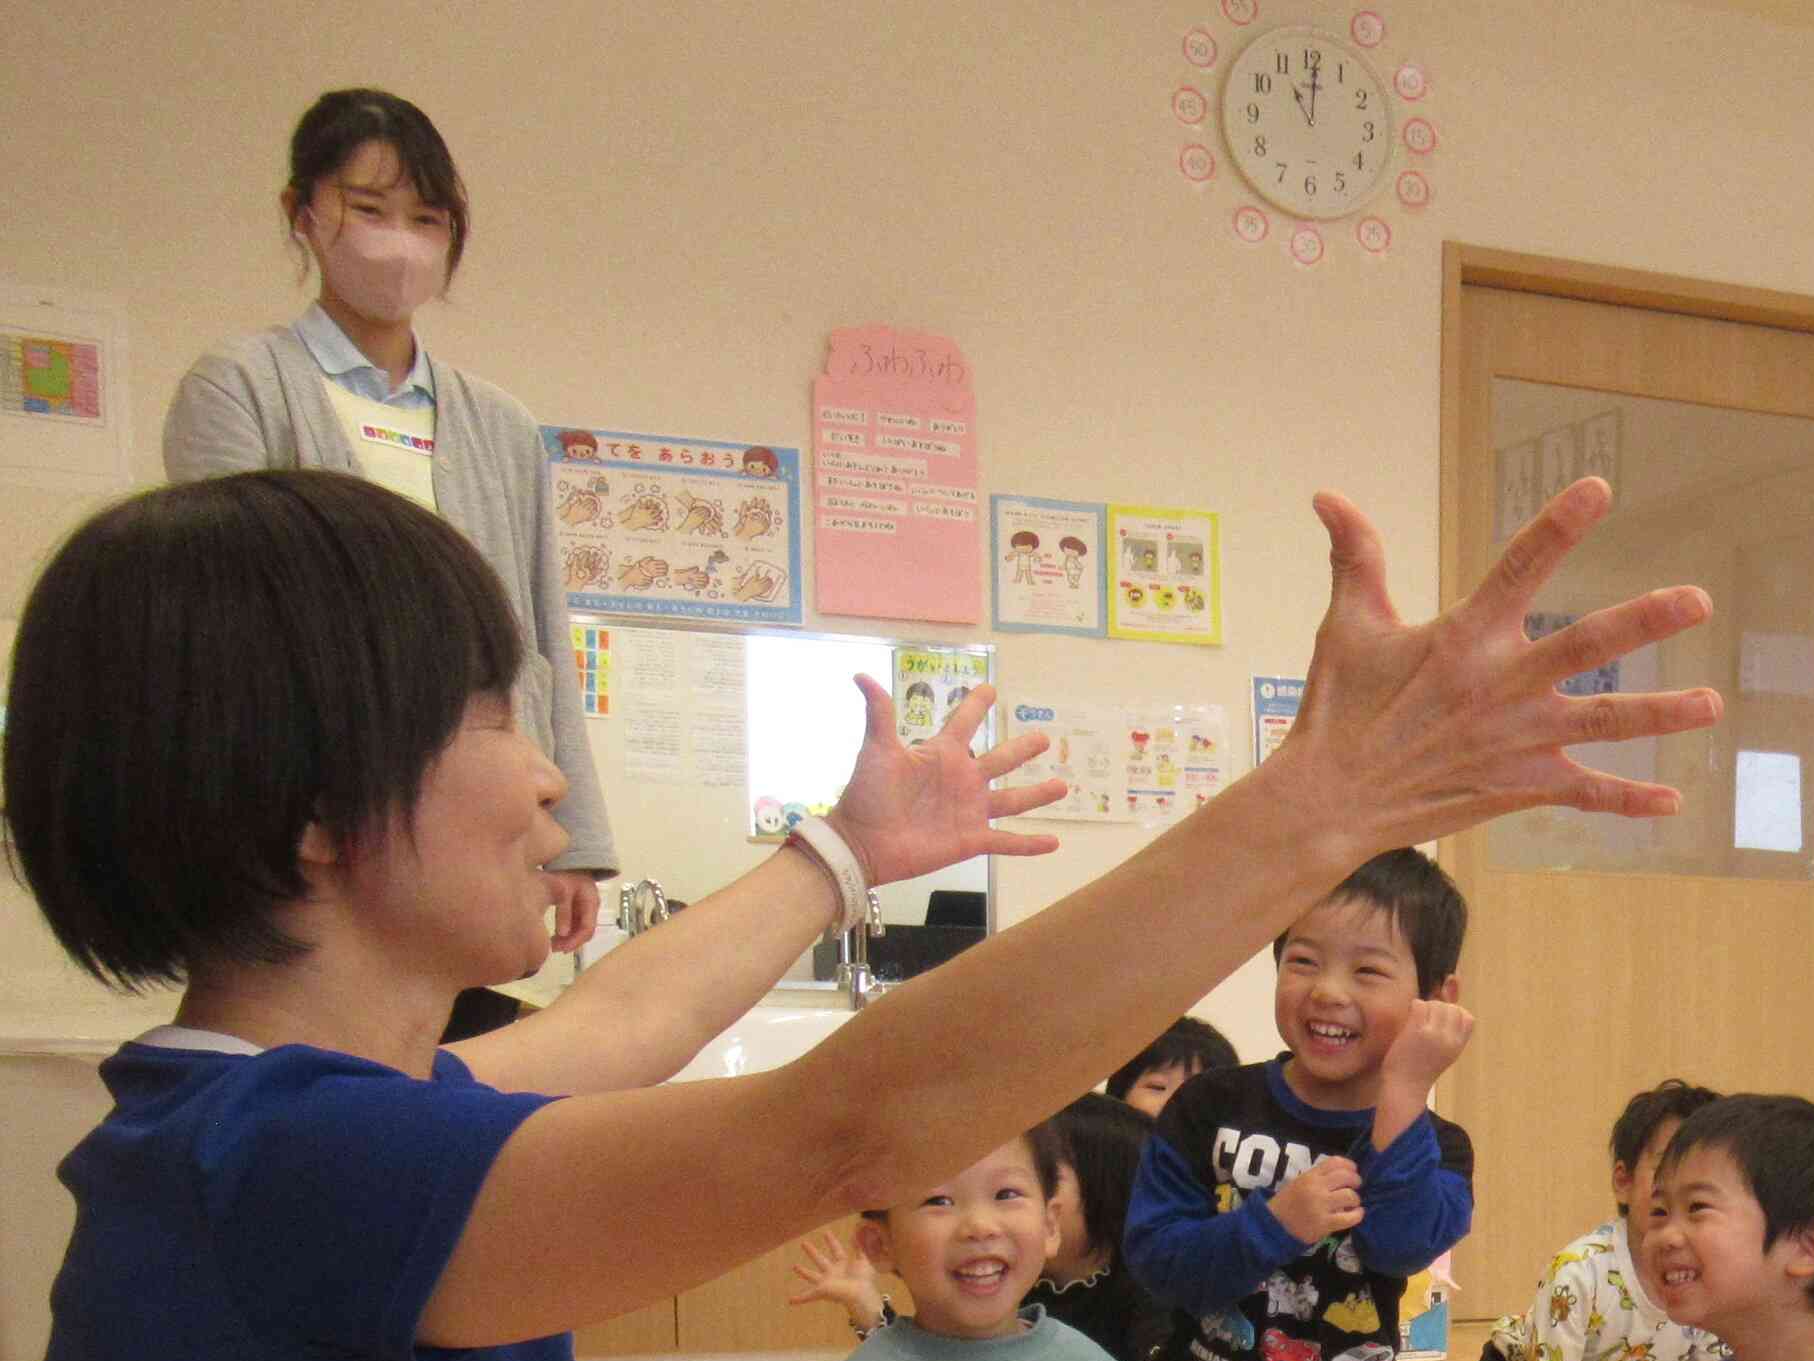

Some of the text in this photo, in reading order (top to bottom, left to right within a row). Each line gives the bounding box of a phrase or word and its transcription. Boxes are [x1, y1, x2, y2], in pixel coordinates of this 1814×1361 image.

[1276, 53, 1289, 75] 11
[1303, 50, 1321, 71] 12
[1254, 72, 1271, 93] 10
[1336, 63, 1344, 84] 1
[1355, 89, 1367, 110] 2
[1246, 103, 1259, 125] 9
[1362, 121, 1375, 143] 3
[1254, 136, 1267, 157] 8
[1352, 151, 1364, 171] 4
[1275, 162, 1288, 183] 7
[1334, 172, 1346, 193] 5
[1304, 175, 1317, 196] 6
[606, 442, 736, 468] てを あらおう
